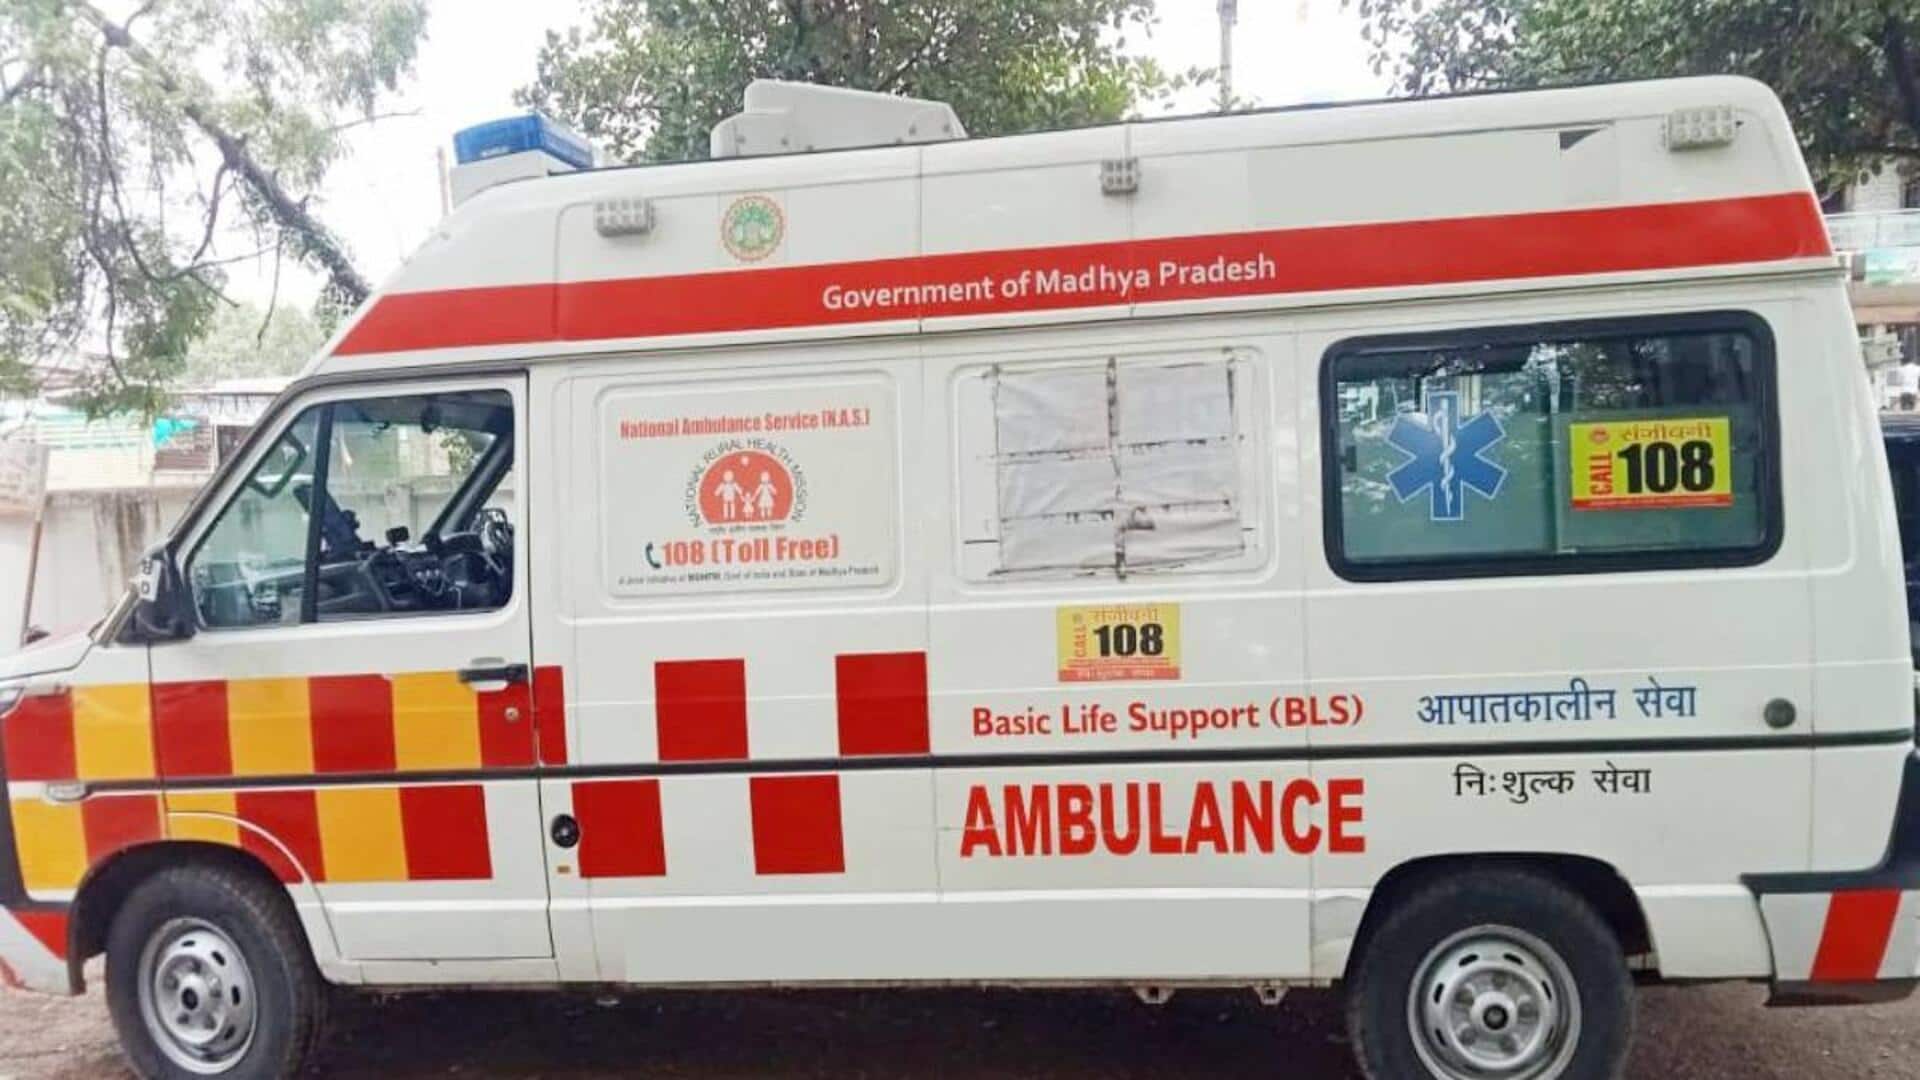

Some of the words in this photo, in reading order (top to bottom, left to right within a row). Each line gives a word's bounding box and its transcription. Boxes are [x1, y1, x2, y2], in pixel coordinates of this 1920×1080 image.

[822, 279, 993, 310] Government
[1002, 276, 1032, 298] of
[1036, 265, 1151, 302] Madhya
[1160, 254, 1276, 285] Pradesh
[620, 417, 679, 439] National
[682, 414, 761, 435] Ambulance
[765, 409, 819, 431] Service
[1589, 452, 1613, 496] CALL
[1617, 440, 1715, 494] 108
[662, 540, 705, 566] 108
[1093, 622, 1164, 657] 108
[973, 706, 1052, 736] Basic
[1062, 704, 1118, 734] Life
[1128, 700, 1259, 740] Support
[1269, 693, 1364, 728] (BLS)
[1417, 677, 1616, 725] आपातकालीन
[1634, 675, 1697, 718] सेवा
[1592, 760, 1652, 794] सेवा
[960, 778, 1367, 857] AMBULANCE
